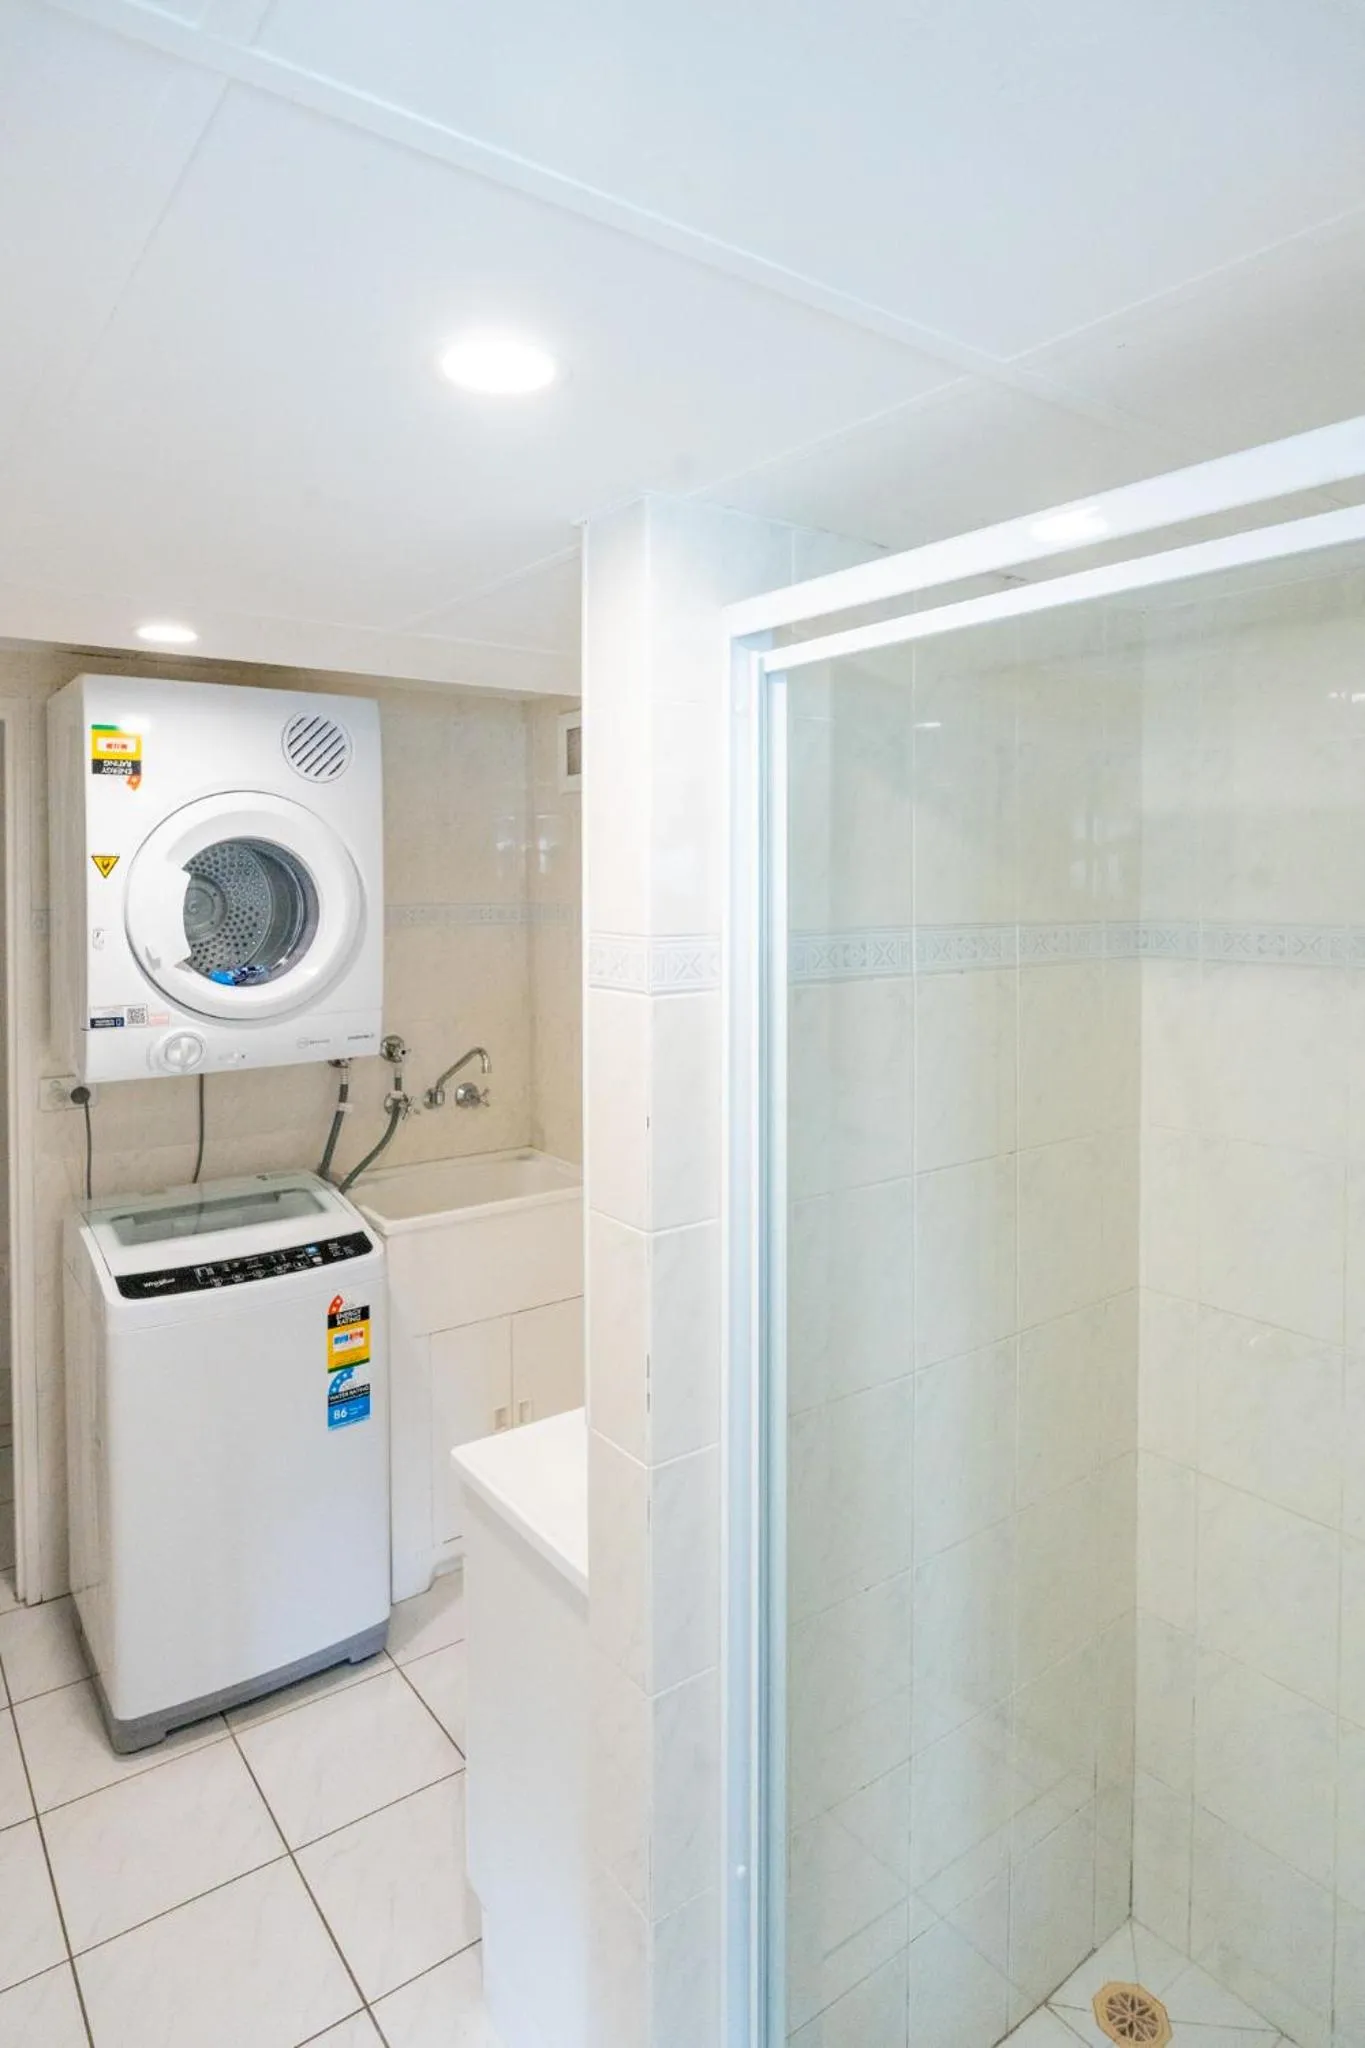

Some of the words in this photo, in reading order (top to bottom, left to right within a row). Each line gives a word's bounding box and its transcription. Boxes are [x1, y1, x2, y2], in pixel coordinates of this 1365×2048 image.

[336, 1308, 361, 1320] ENERGY
[336, 1315, 361, 1326] RATING
[329, 1391, 348, 1401] WATER
[349, 1385, 369, 1396] RATING
